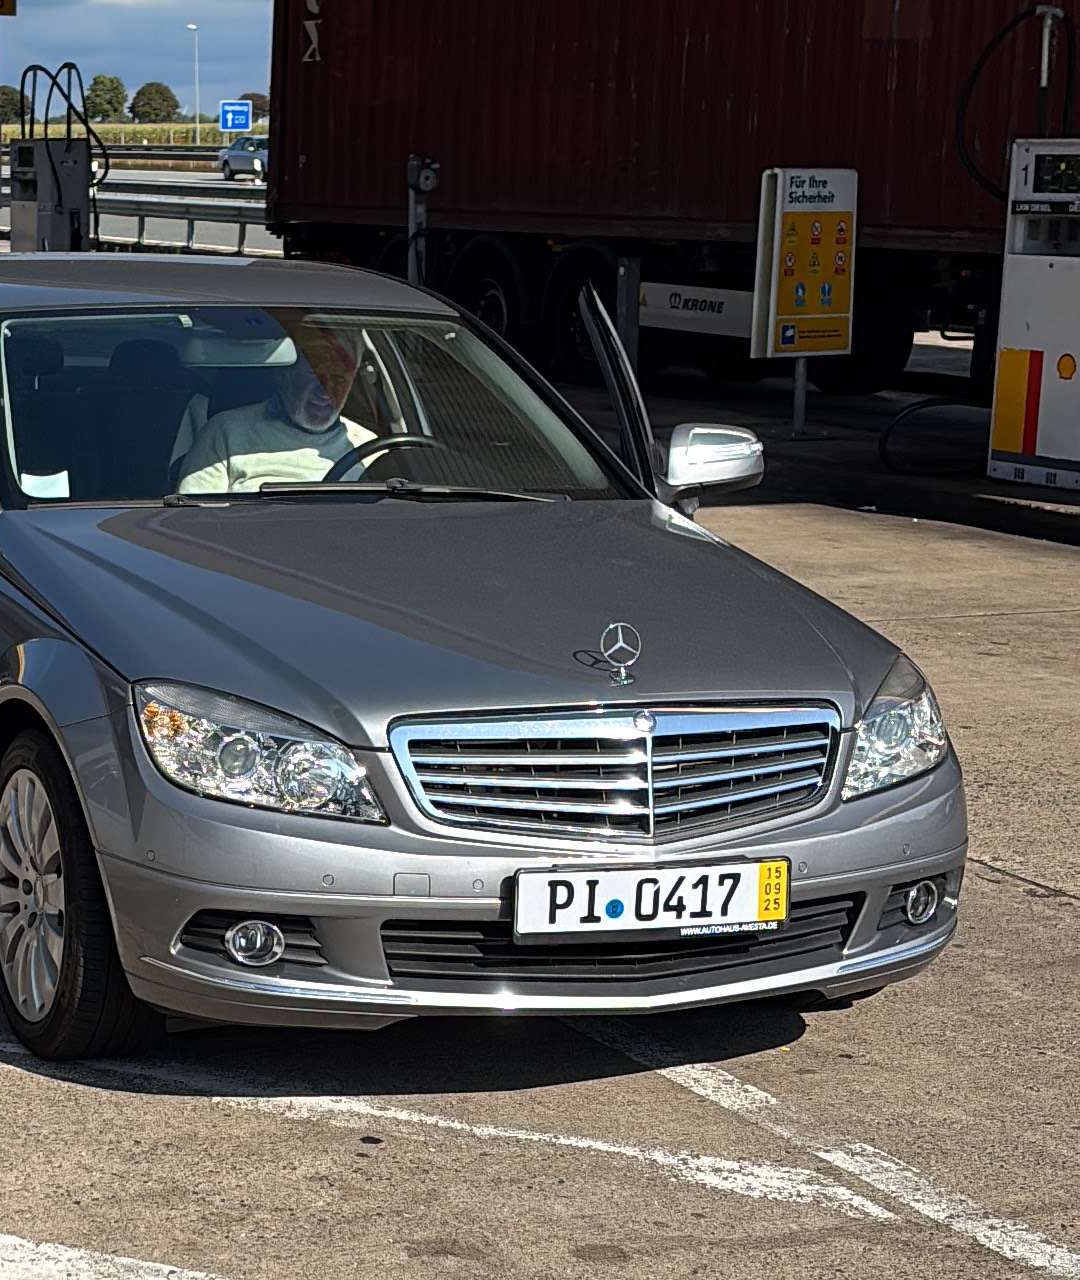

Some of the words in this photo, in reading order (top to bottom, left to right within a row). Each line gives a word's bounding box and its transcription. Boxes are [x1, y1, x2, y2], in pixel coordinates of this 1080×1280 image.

[1022, 164, 1029, 186] 1
[789, 176, 807, 189] Für
[809, 176, 828, 189] Ihre
[788, 191, 835, 204] Sicherheit
[683, 298, 724, 314] KRONE
[767, 867, 782, 879] 15
[765, 882, 781, 895] 09
[548, 879, 601, 924] PI
[635, 873, 741, 921] 0417
[763, 898, 780, 911] 25
